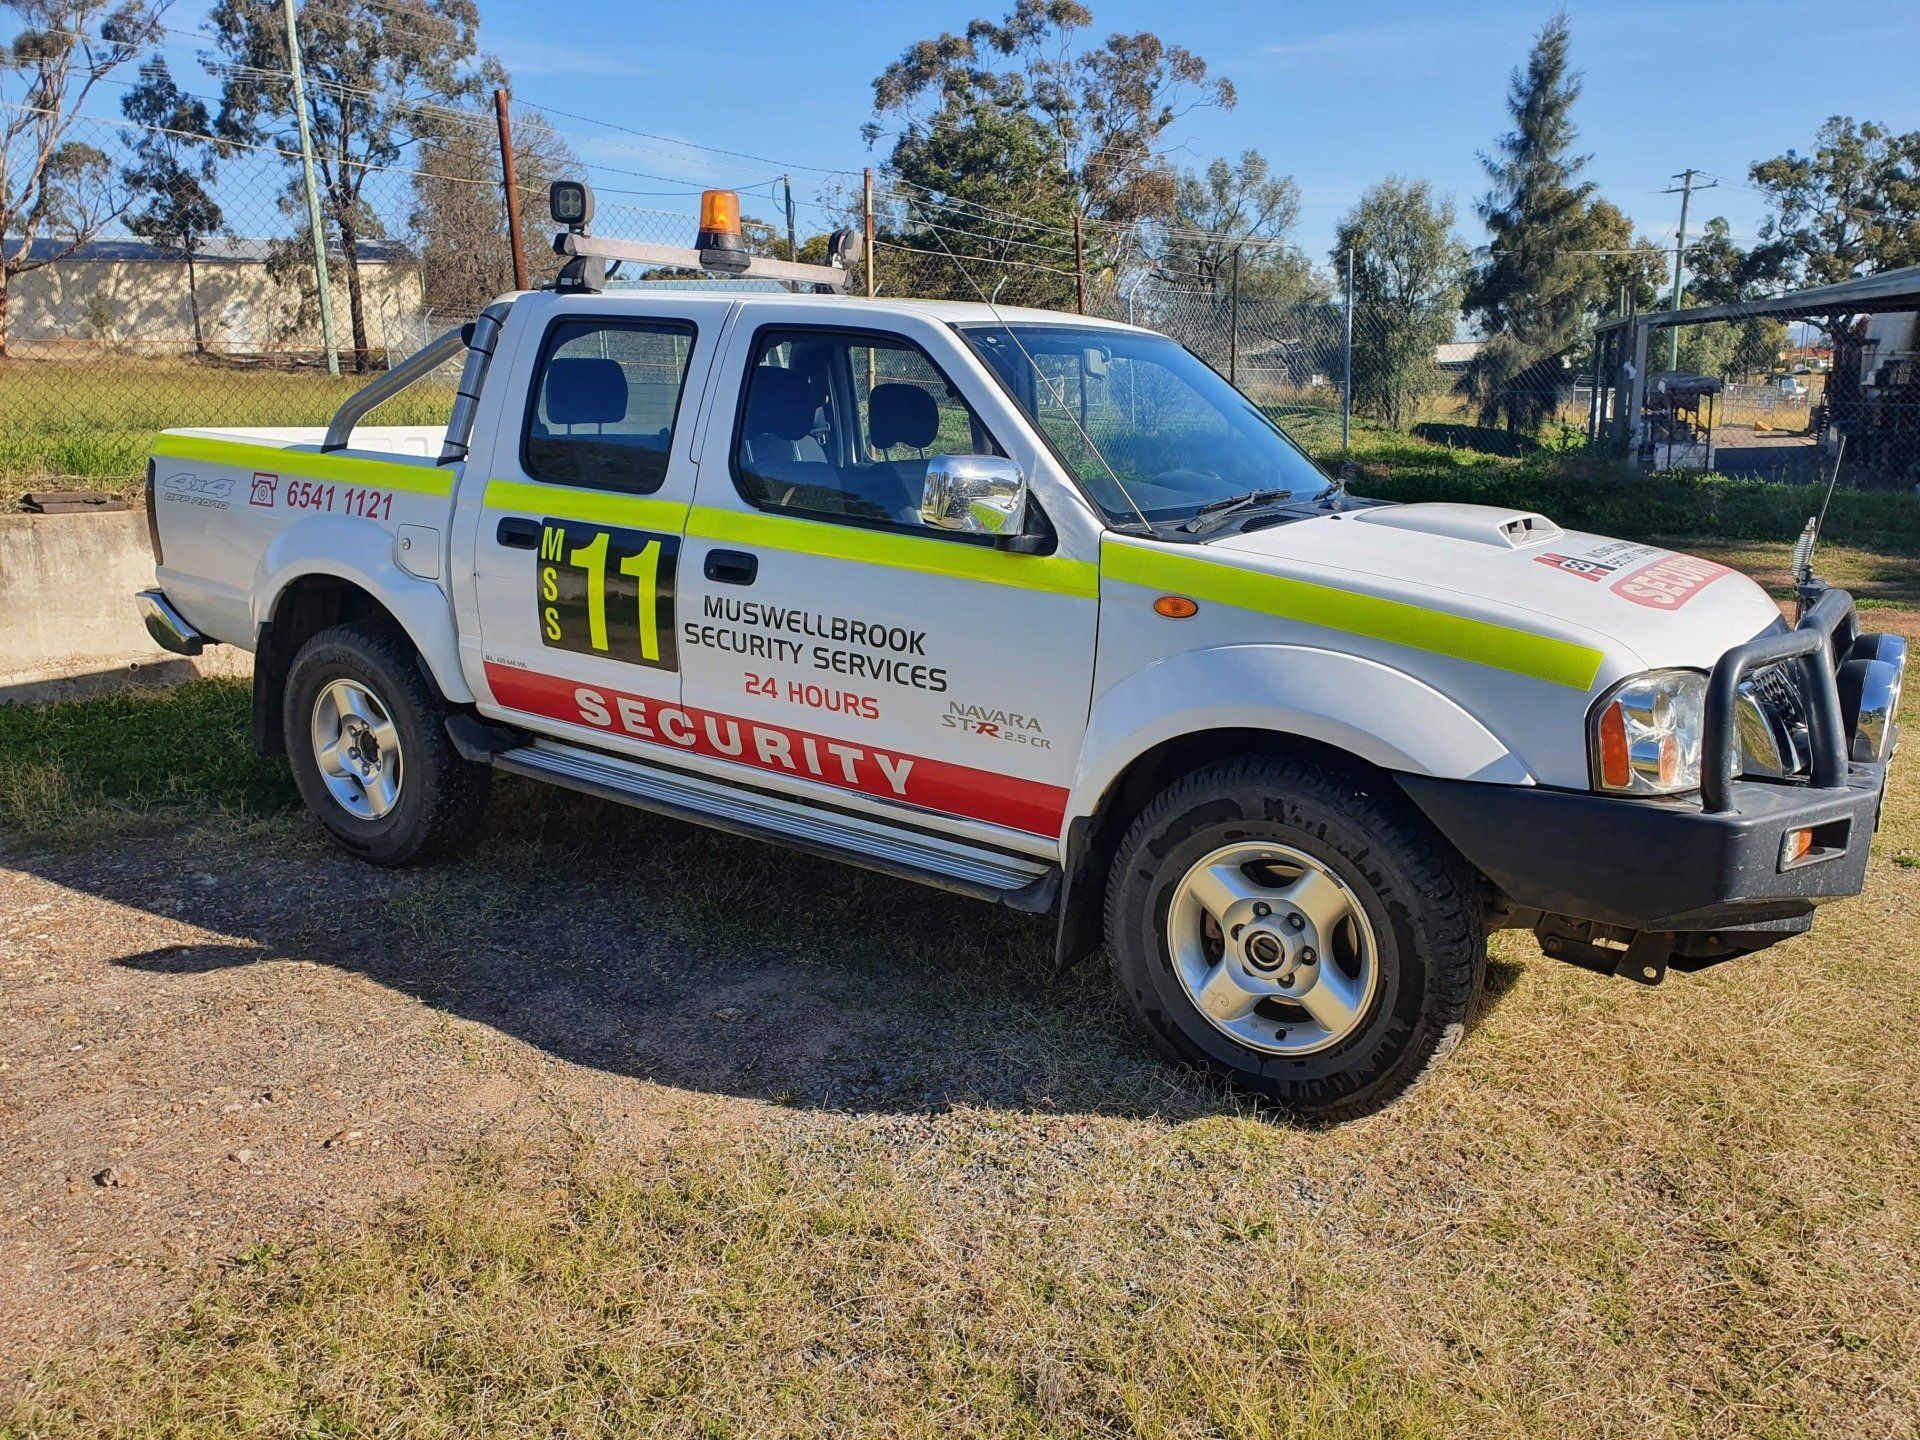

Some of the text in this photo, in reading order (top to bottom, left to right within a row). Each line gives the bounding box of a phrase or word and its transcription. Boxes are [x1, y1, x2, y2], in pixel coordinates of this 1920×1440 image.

[164, 472, 236, 498] 4x4
[165, 492, 230, 509] OFF ROAD
[286, 480, 394, 520] 6541 1121
[570, 532, 662, 662] 11
[703, 595, 926, 656] MUSWELLBROOK
[684, 622, 948, 693] SECURITY SERVICES
[744, 672, 880, 720] 24 HOURS
[949, 700, 1043, 733] NAVARA
[574, 687, 915, 796] SECURITY
[941, 714, 1051, 749] ST-R 2.5 CR
